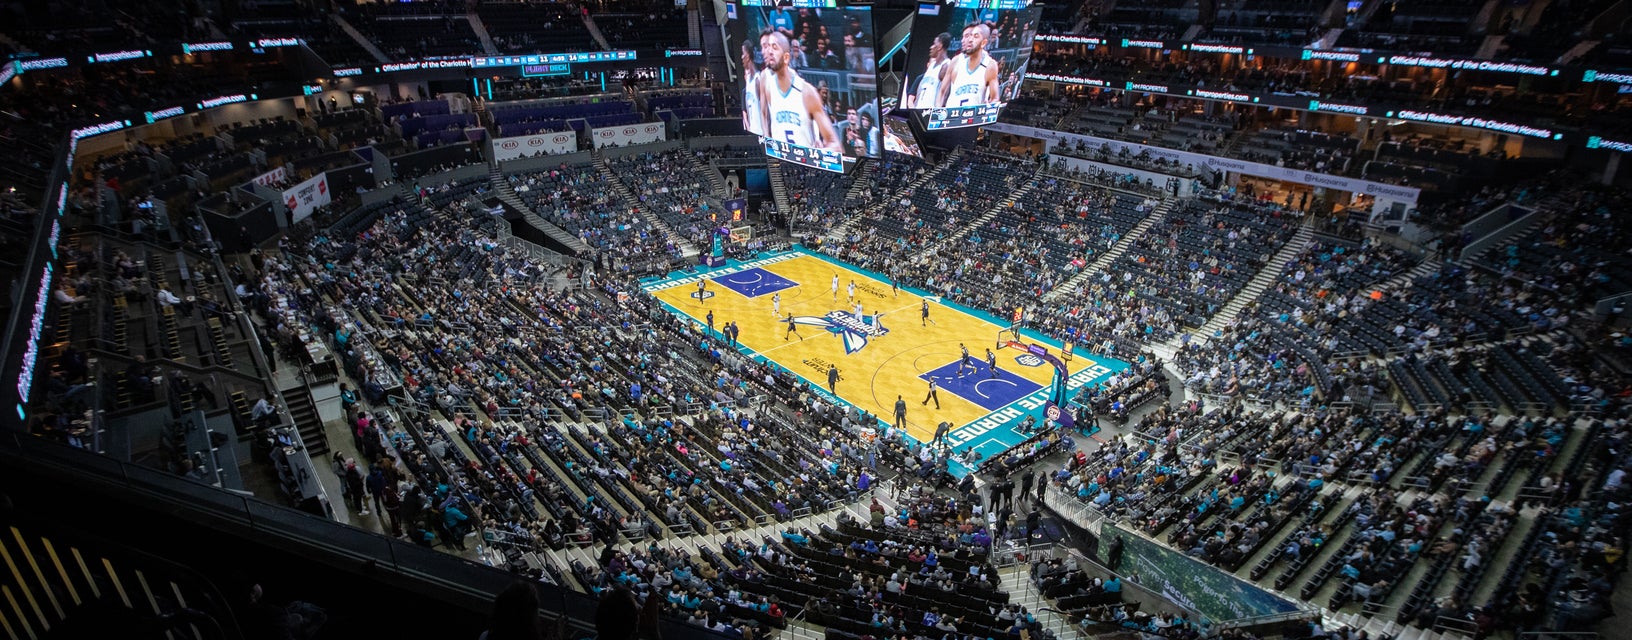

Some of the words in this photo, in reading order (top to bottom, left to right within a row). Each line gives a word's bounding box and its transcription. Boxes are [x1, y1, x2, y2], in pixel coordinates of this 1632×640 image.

[1190, 43, 1242, 54] hmproperties.com
[1321, 52, 1360, 62] PROPERTIES
[382, 64, 400, 72] Official
[440, 60, 466, 68] Charlotte
[1390, 56, 1418, 66] Official
[1464, 60, 1480, 70] the
[1480, 62, 1517, 73] Charlotte
[1196, 89, 1248, 102] hmproperties.com
[951, 110, 959, 118] 11
[978, 107, 986, 115] 14
[1329, 104, 1368, 114] PROPERTIES
[1398, 110, 1428, 121] Official
[1473, 118, 1486, 128] the
[780, 142, 790, 152] 11
[809, 148, 820, 159] 14
[1214, 160, 1244, 170] Husqvarna
[1312, 175, 1348, 188] Husqvarna
[298, 184, 316, 199] COMFORT
[1374, 186, 1414, 198] Husqvarna
[738, 251, 808, 272] HORNETS
[1193, 575, 1218, 600] Power
[1228, 602, 1244, 619] The
